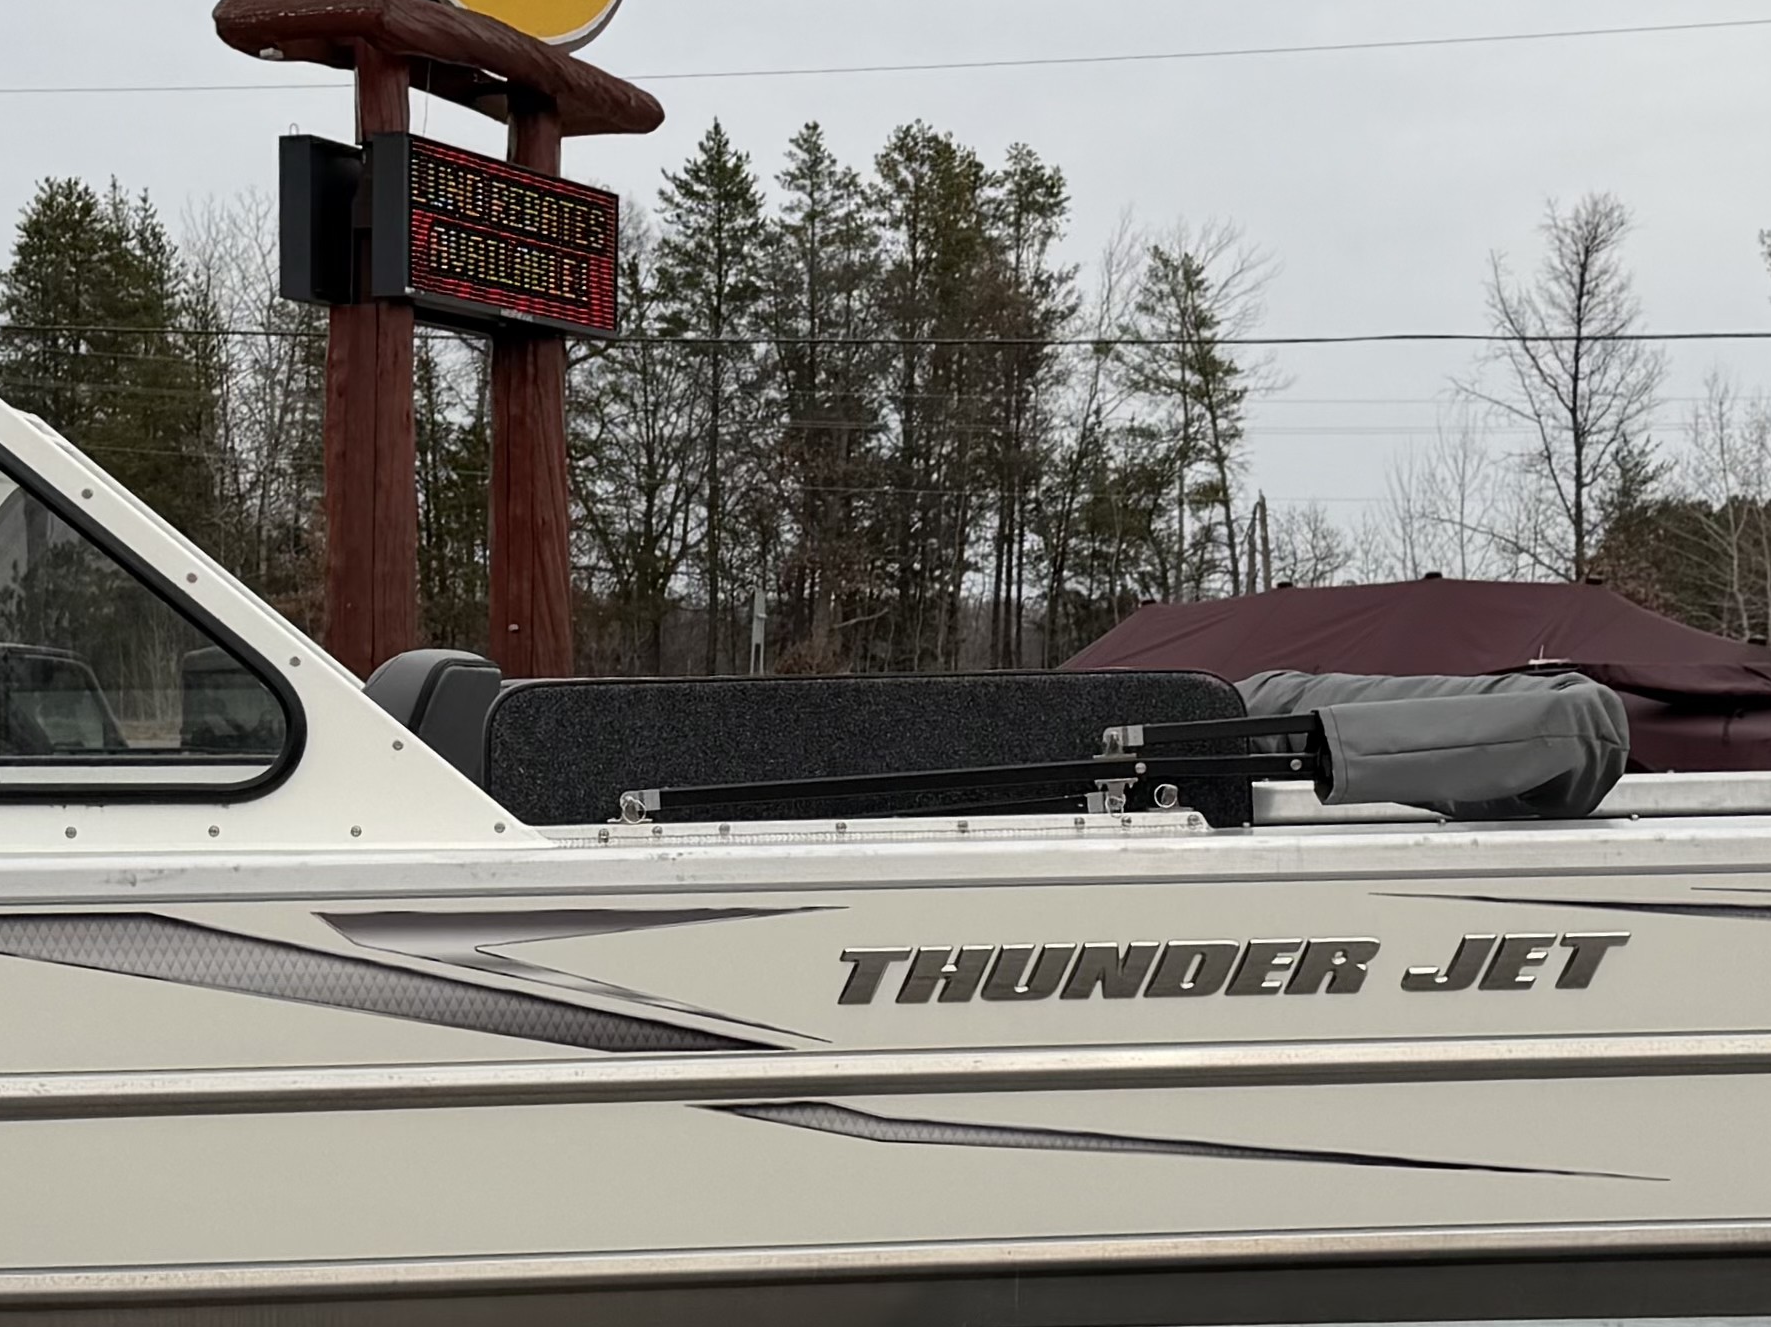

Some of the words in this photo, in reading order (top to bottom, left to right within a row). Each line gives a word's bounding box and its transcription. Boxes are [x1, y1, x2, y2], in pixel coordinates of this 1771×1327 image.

[491, 180, 606, 249] REBATES
[429, 226, 589, 302] AVAILABLE!
[837, 936, 1382, 1005] THUNDER
[1400, 931, 1632, 992] JET
